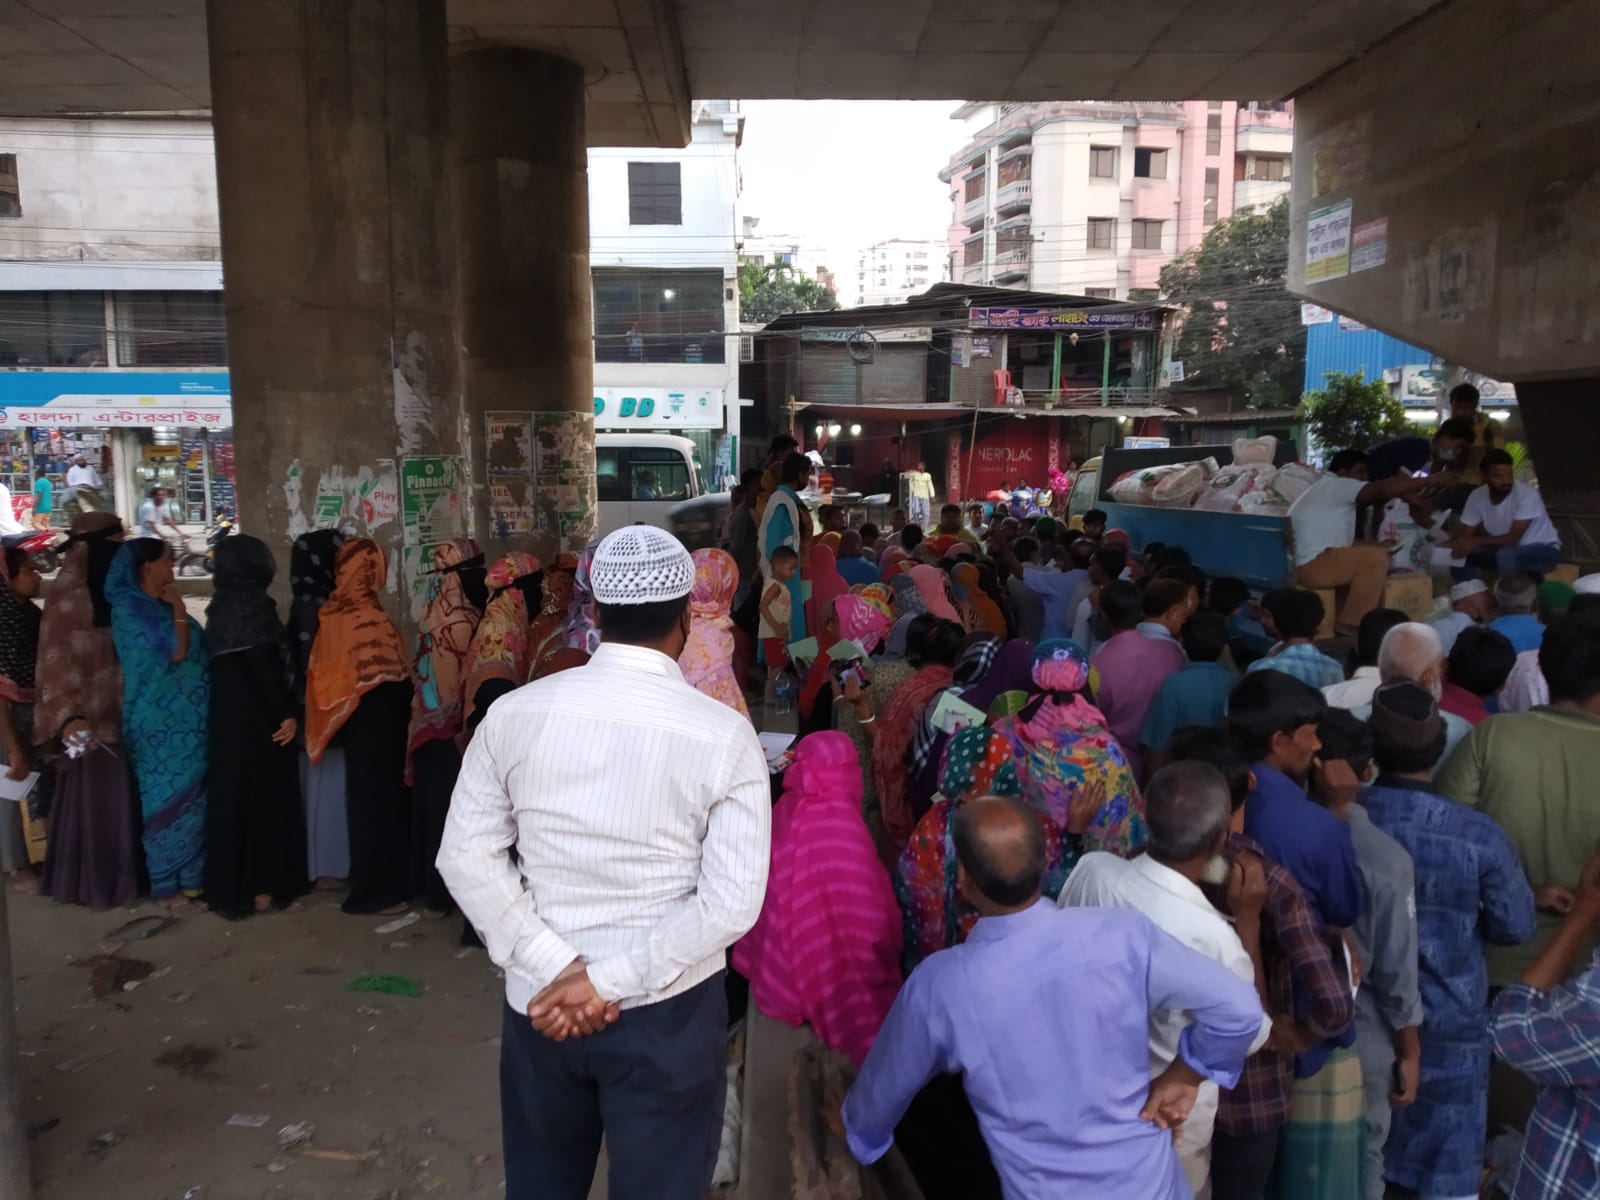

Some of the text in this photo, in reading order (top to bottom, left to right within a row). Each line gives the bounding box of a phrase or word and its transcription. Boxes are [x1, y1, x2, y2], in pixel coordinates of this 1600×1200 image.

[619, 397, 655, 417] BD
[16, 410, 223, 424] হালদা এন্টারপ্রাইজ
[977, 447, 1033, 462] NEROLAC
[1048, 438, 1058, 469] ROLAC
[374, 491, 396, 502] Play
